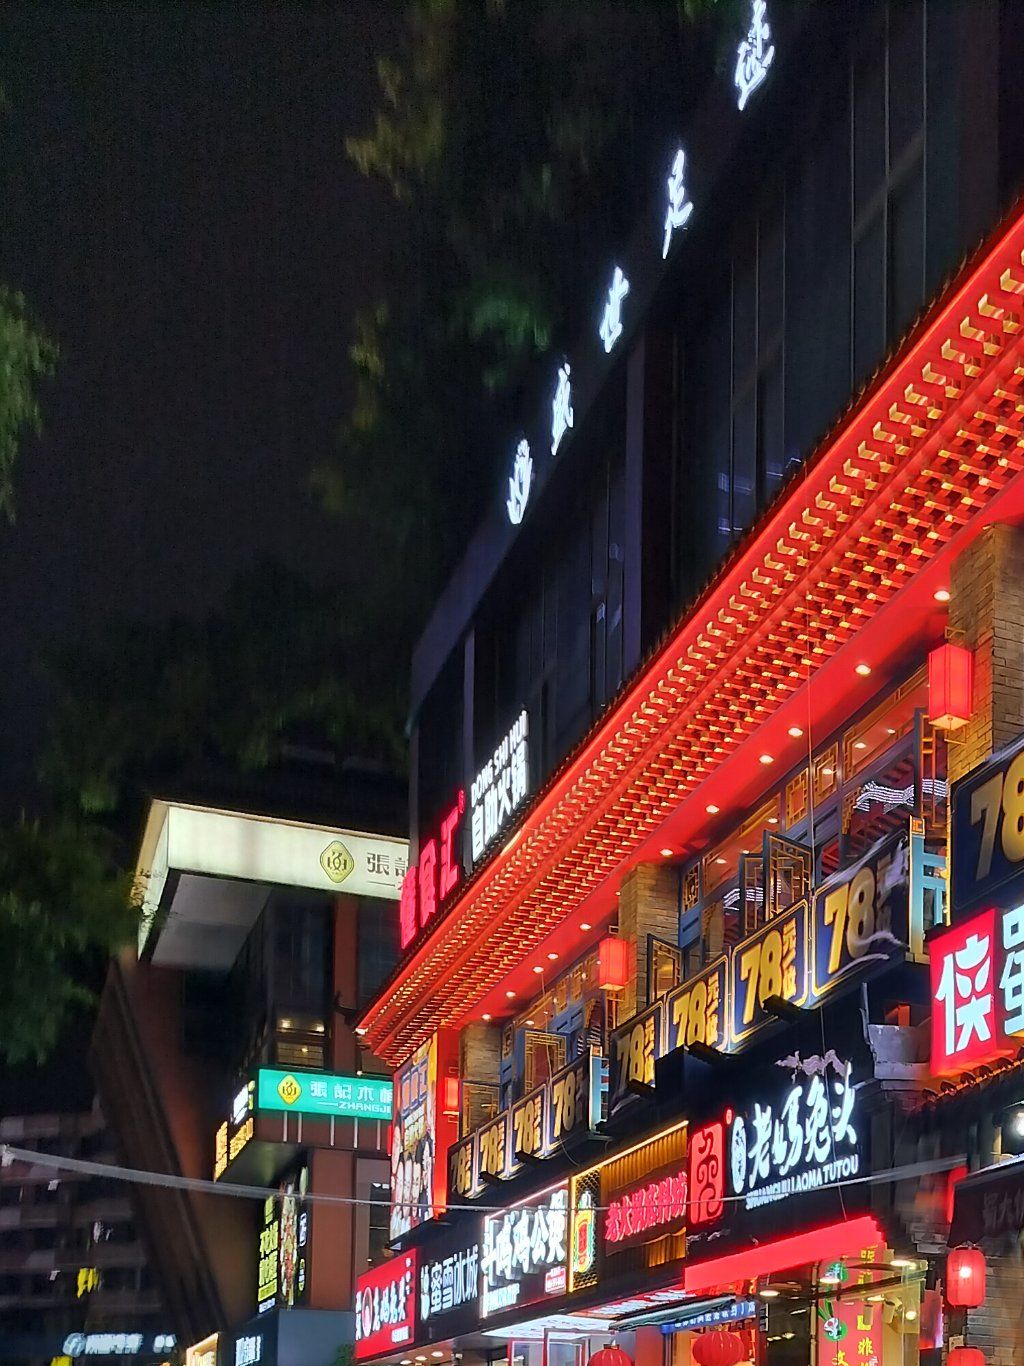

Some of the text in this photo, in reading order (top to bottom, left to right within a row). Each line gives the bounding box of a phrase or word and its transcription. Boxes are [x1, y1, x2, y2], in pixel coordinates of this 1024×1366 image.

[823, 867, 878, 975] 78
[740, 930, 783, 1025] 78
[672, 980, 708, 1048] 78
[617, 1023, 645, 1092] 78
[514, 1099, 534, 1155] 78
[552, 1072, 576, 1138] 78
[479, 1125, 498, 1175] 78
[823, 1153, 859, 1184] TUTOU
[430, 1244, 479, 1314] 蜜雪冰城
